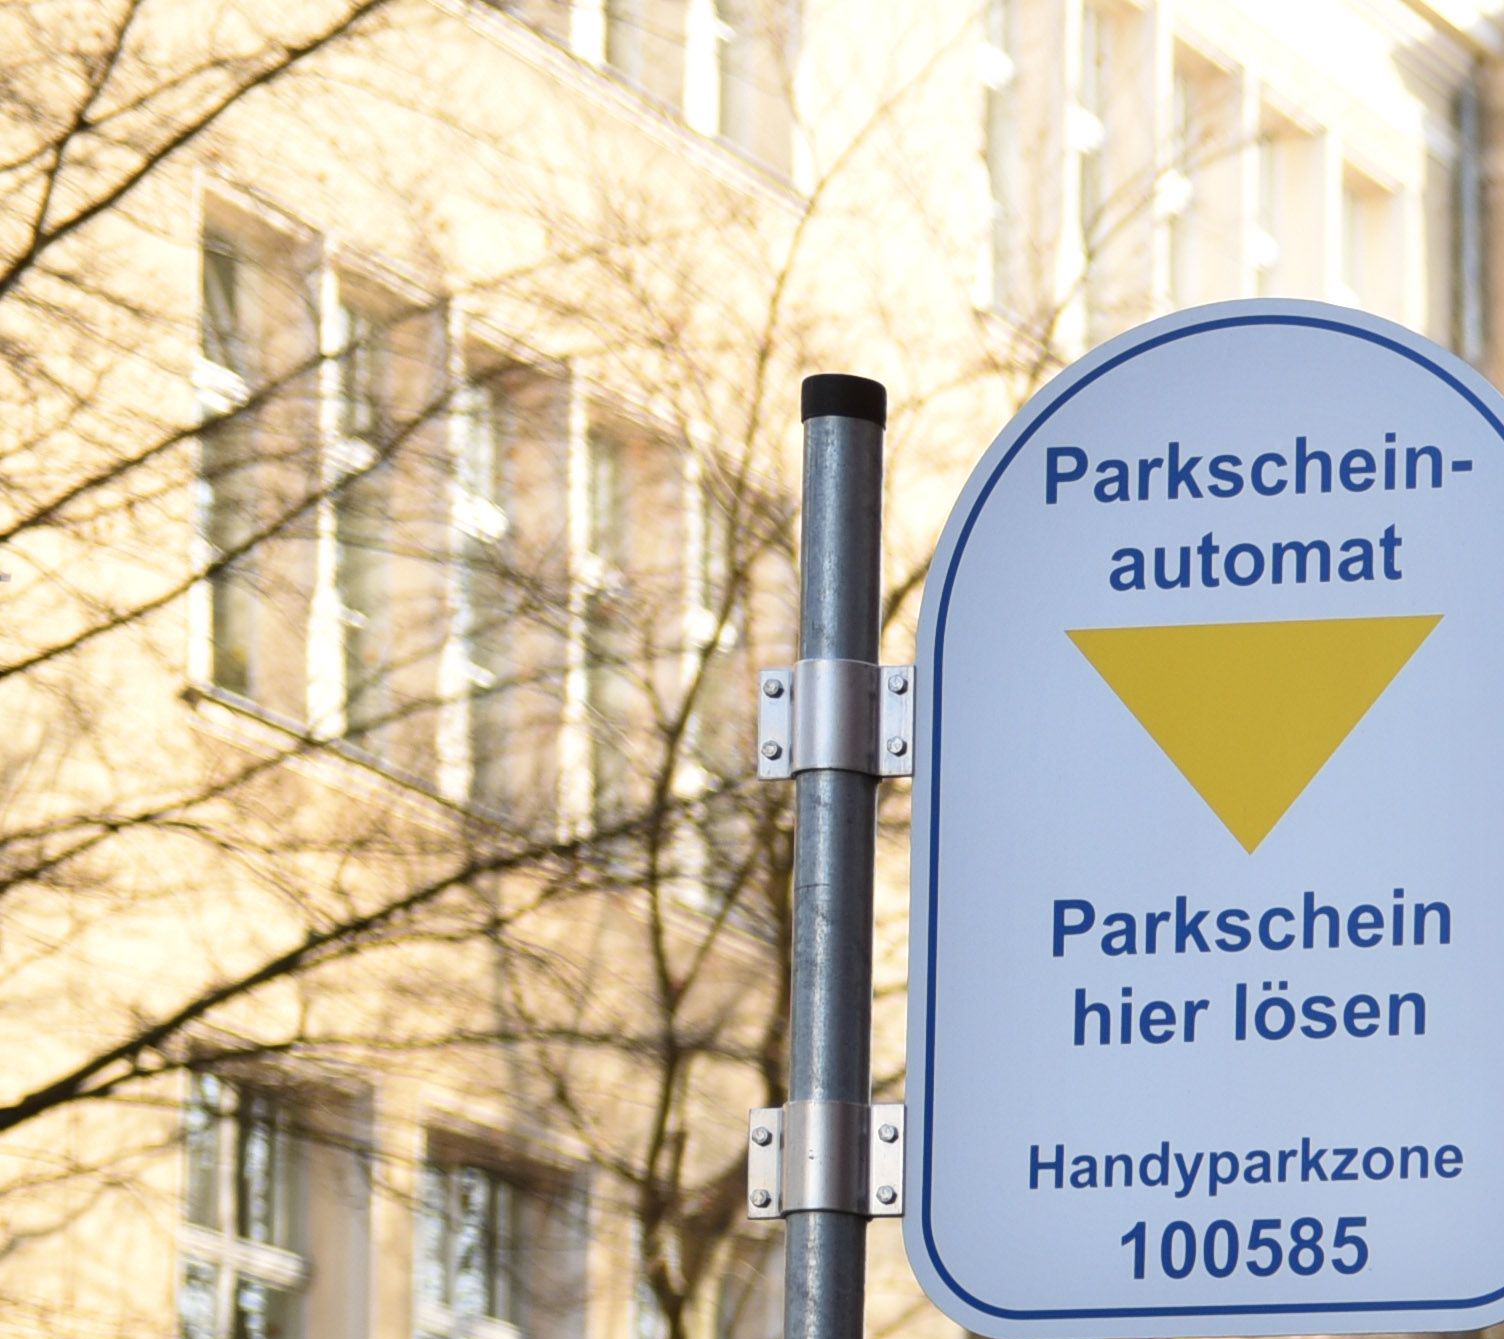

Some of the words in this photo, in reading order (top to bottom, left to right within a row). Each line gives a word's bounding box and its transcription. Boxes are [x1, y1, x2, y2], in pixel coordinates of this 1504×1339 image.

[1045, 432, 1473, 505] Parkschein-
[1108, 522, 1403, 592] automat
[1051, 888, 1452, 958] Parkschein
[1072, 986, 1209, 1048] hier
[1233, 979, 1427, 1042] lösen
[1028, 1136, 1464, 1200] Handyparkzone
[1119, 1216, 1370, 1282] 100585
